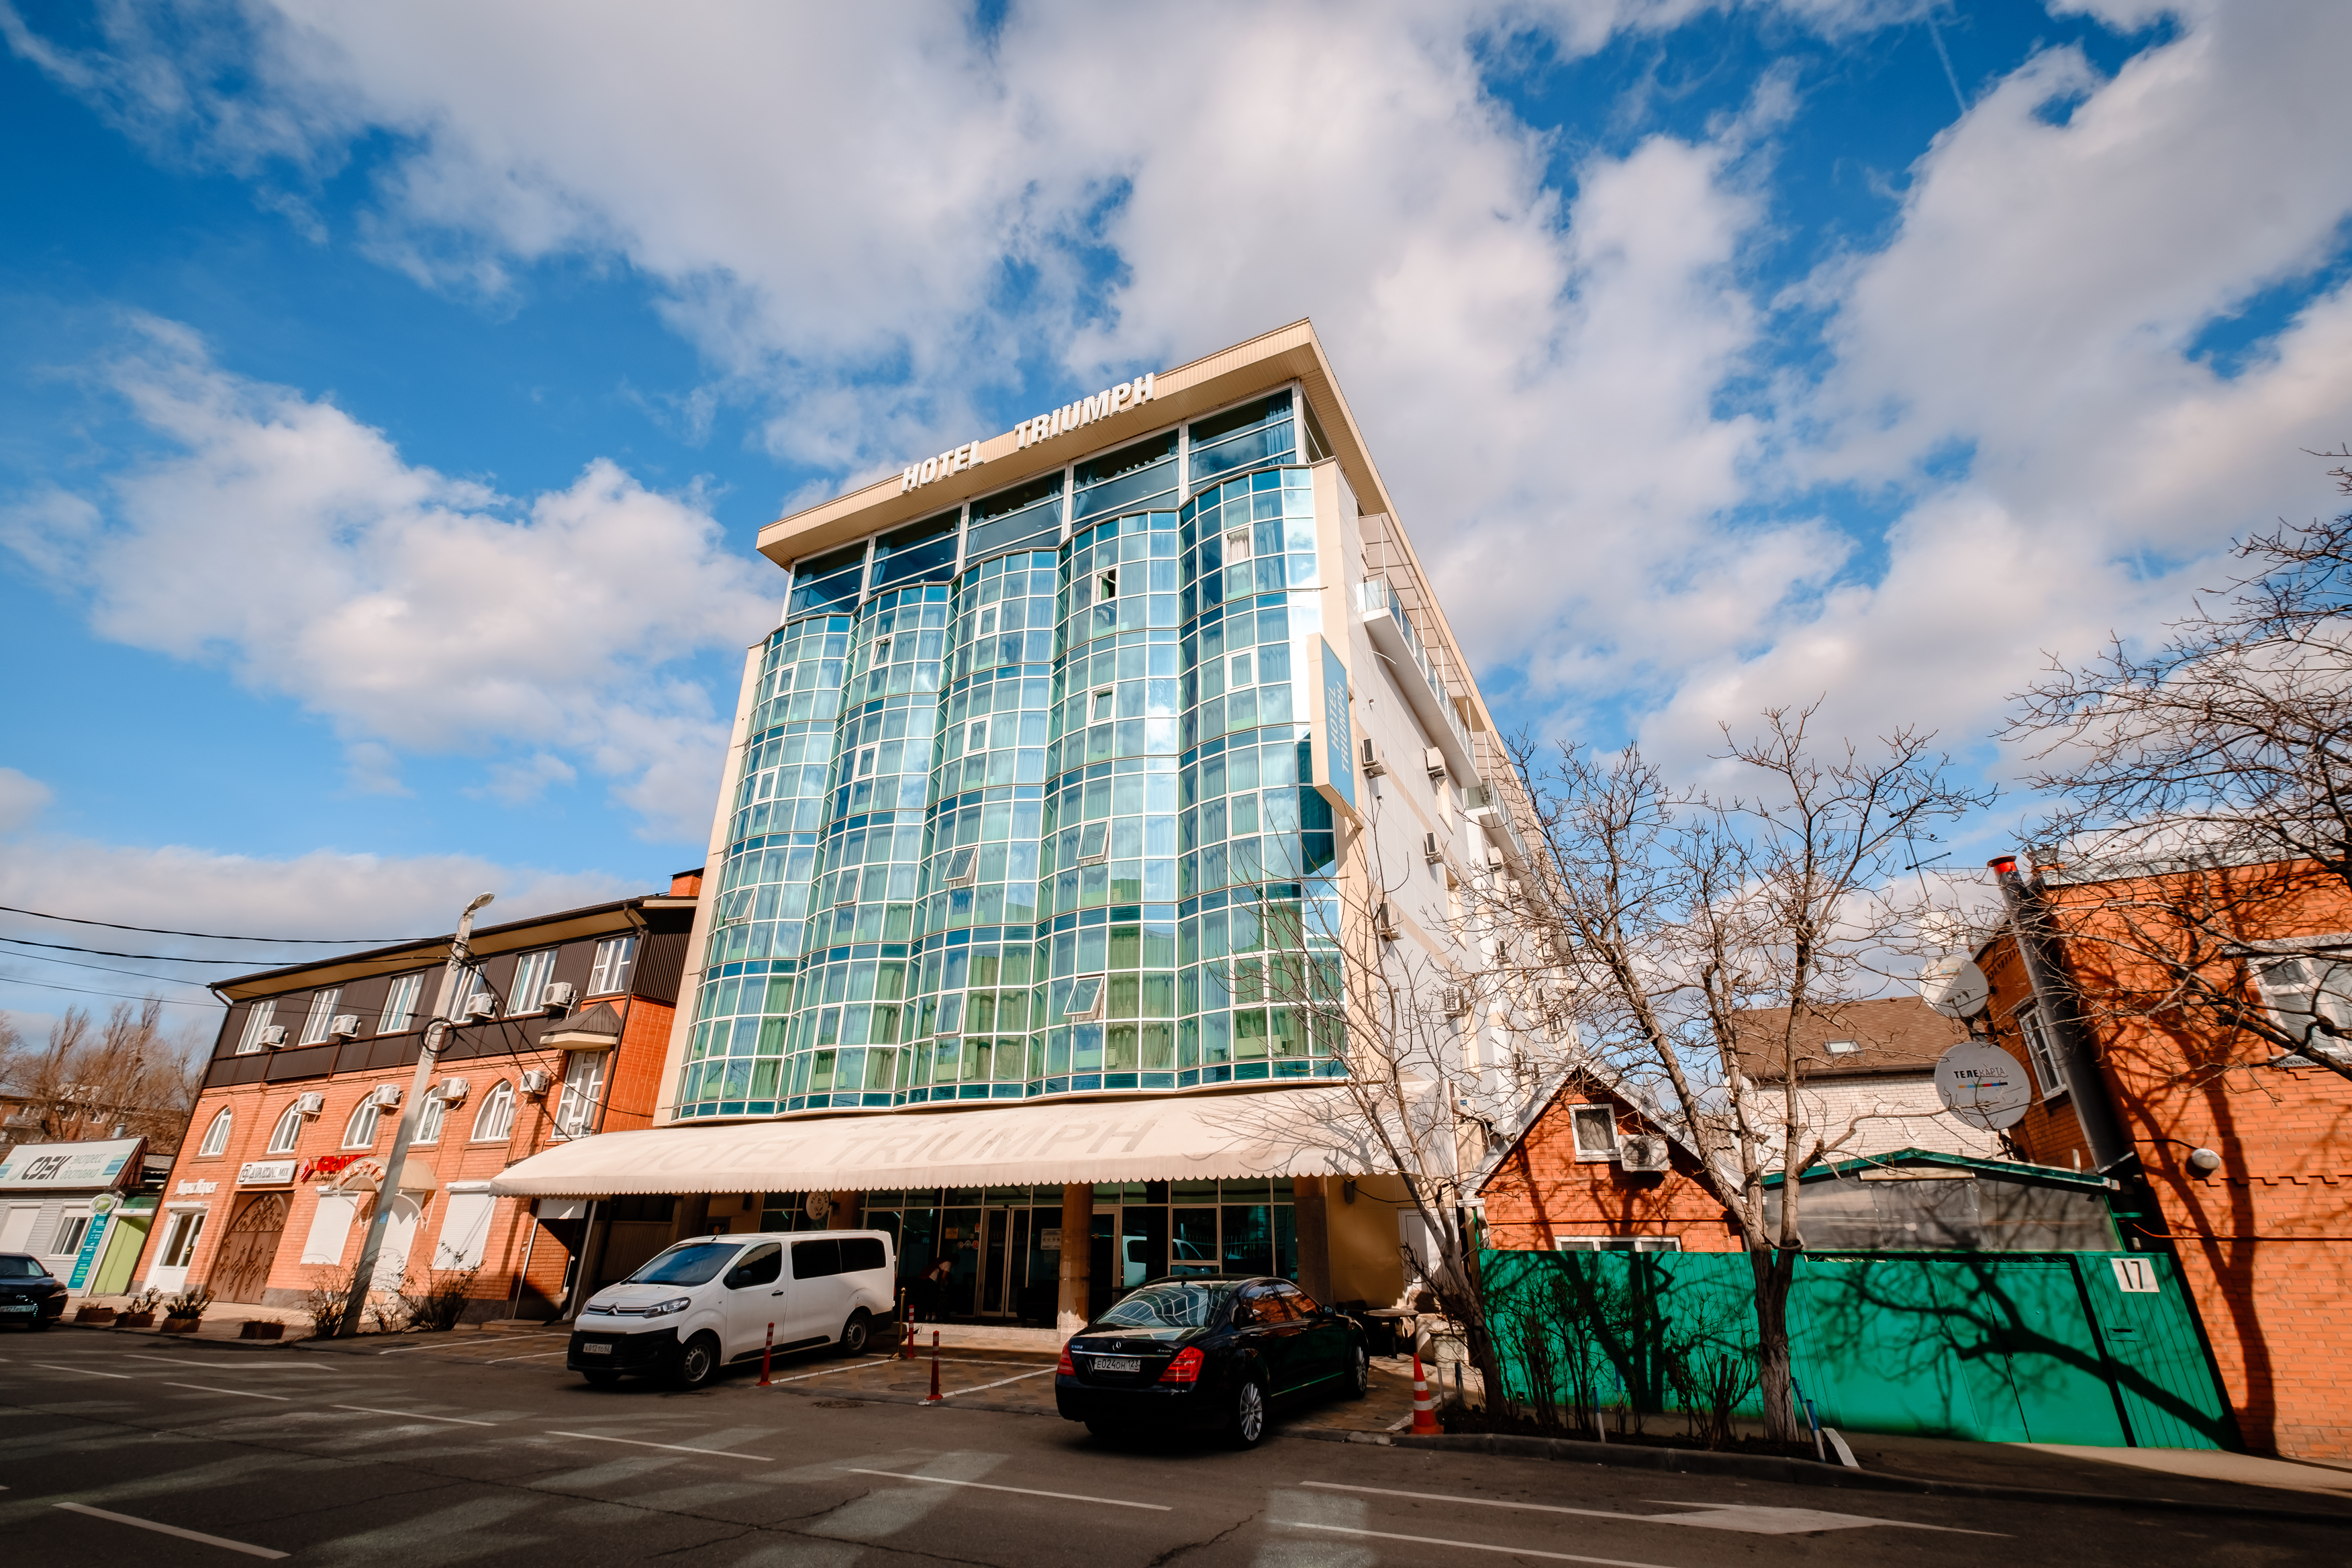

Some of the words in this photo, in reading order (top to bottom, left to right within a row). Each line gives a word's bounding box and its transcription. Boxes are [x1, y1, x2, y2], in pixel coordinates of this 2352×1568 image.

[901, 440, 985, 493] HOTEL
[1014, 372, 1155, 450] TRIUMPH
[1328, 685, 1340, 751] HOTEL
[1336, 681, 1350, 775] TRIUMPH
[1953, 1067, 2006, 1079] ТЕЛЕКАРТА
[616, 1139, 806, 1172] HOTEL
[826, 1119, 1159, 1166] TRIUMPH
[2120, 1261, 2144, 1289] 17
[1097, 1359, 1126, 1369] Е024ОН
[1127, 1359, 1138, 1368] 123
